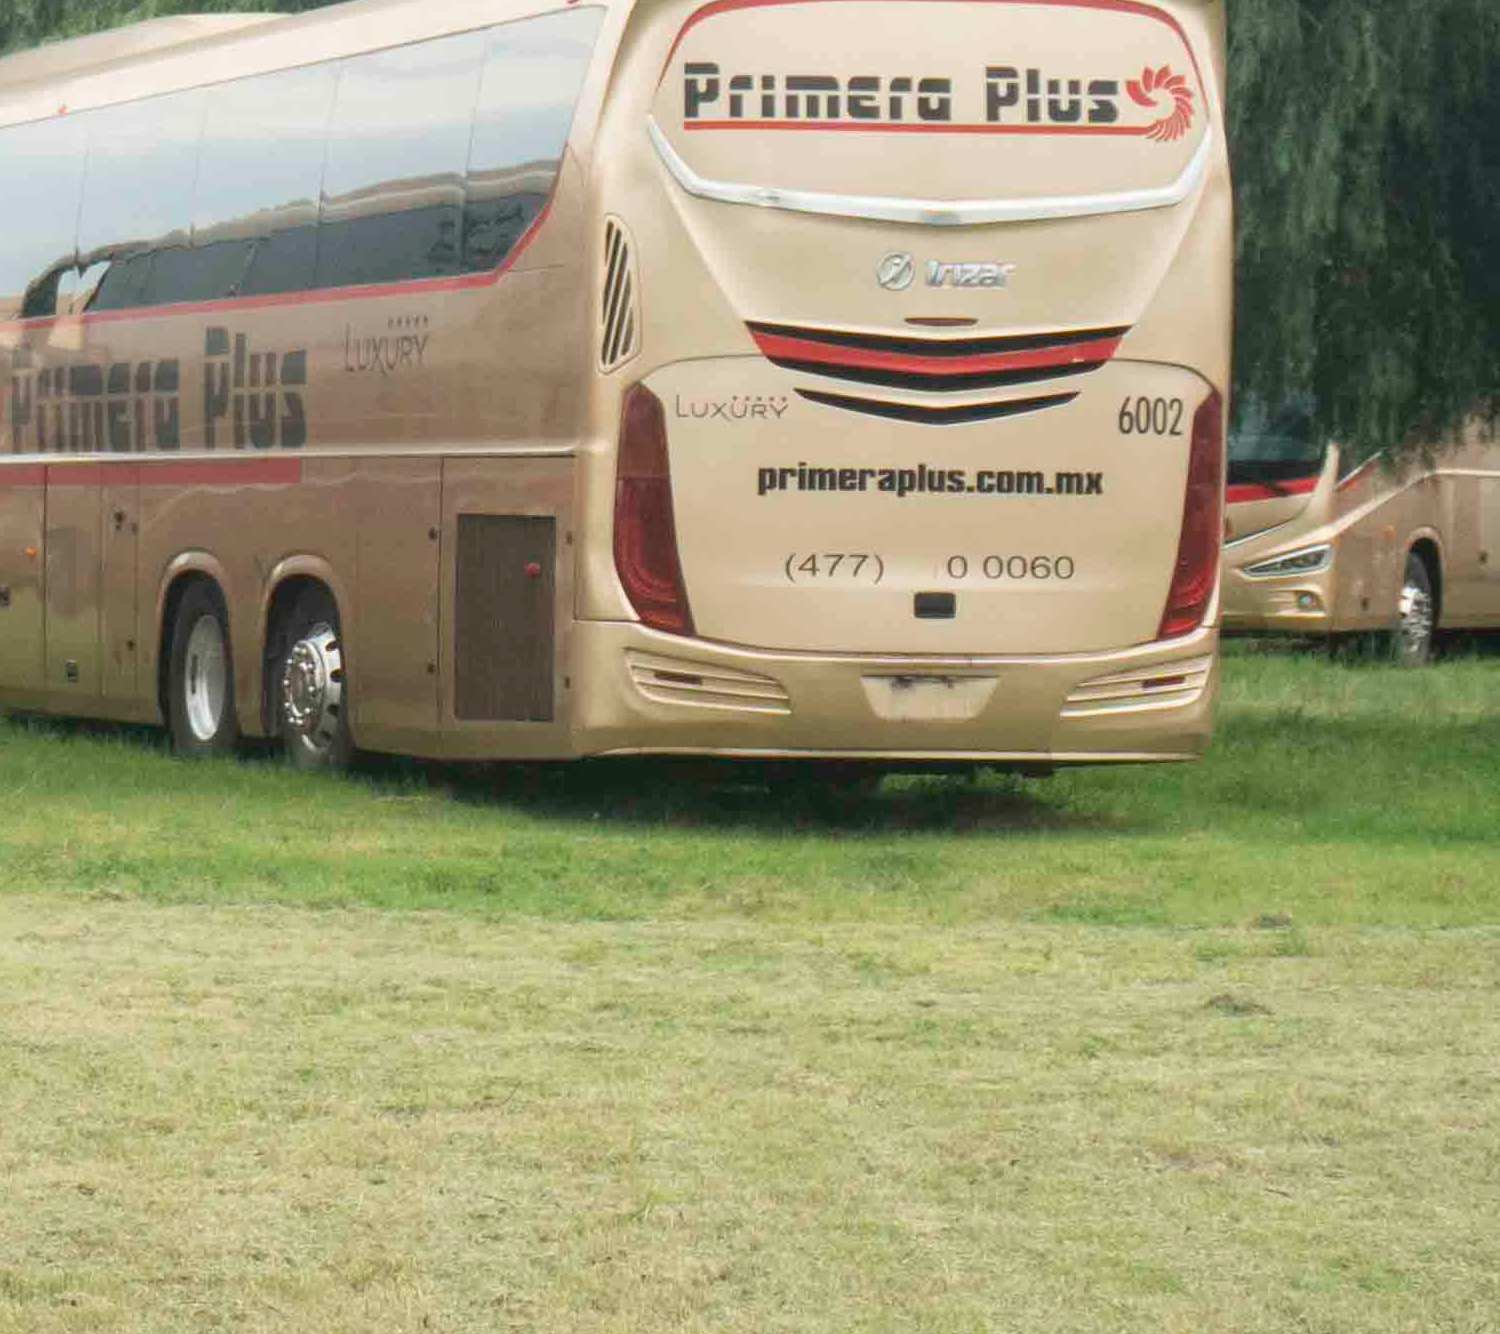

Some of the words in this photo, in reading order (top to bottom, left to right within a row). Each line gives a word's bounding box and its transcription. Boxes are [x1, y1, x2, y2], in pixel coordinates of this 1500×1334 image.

[683, 62, 952, 121] Primera
[985, 66, 1119, 124] Plus
[10, 345, 180, 453] Primera
[203, 326, 308, 450] Plus
[674, 394, 790, 422] LUXURY
[1117, 396, 1184, 436] 6002
[757, 462, 1104, 496] primeraplus.com.mx
[784, 552, 886, 584] (477)
[982, 554, 1076, 581] 0060
